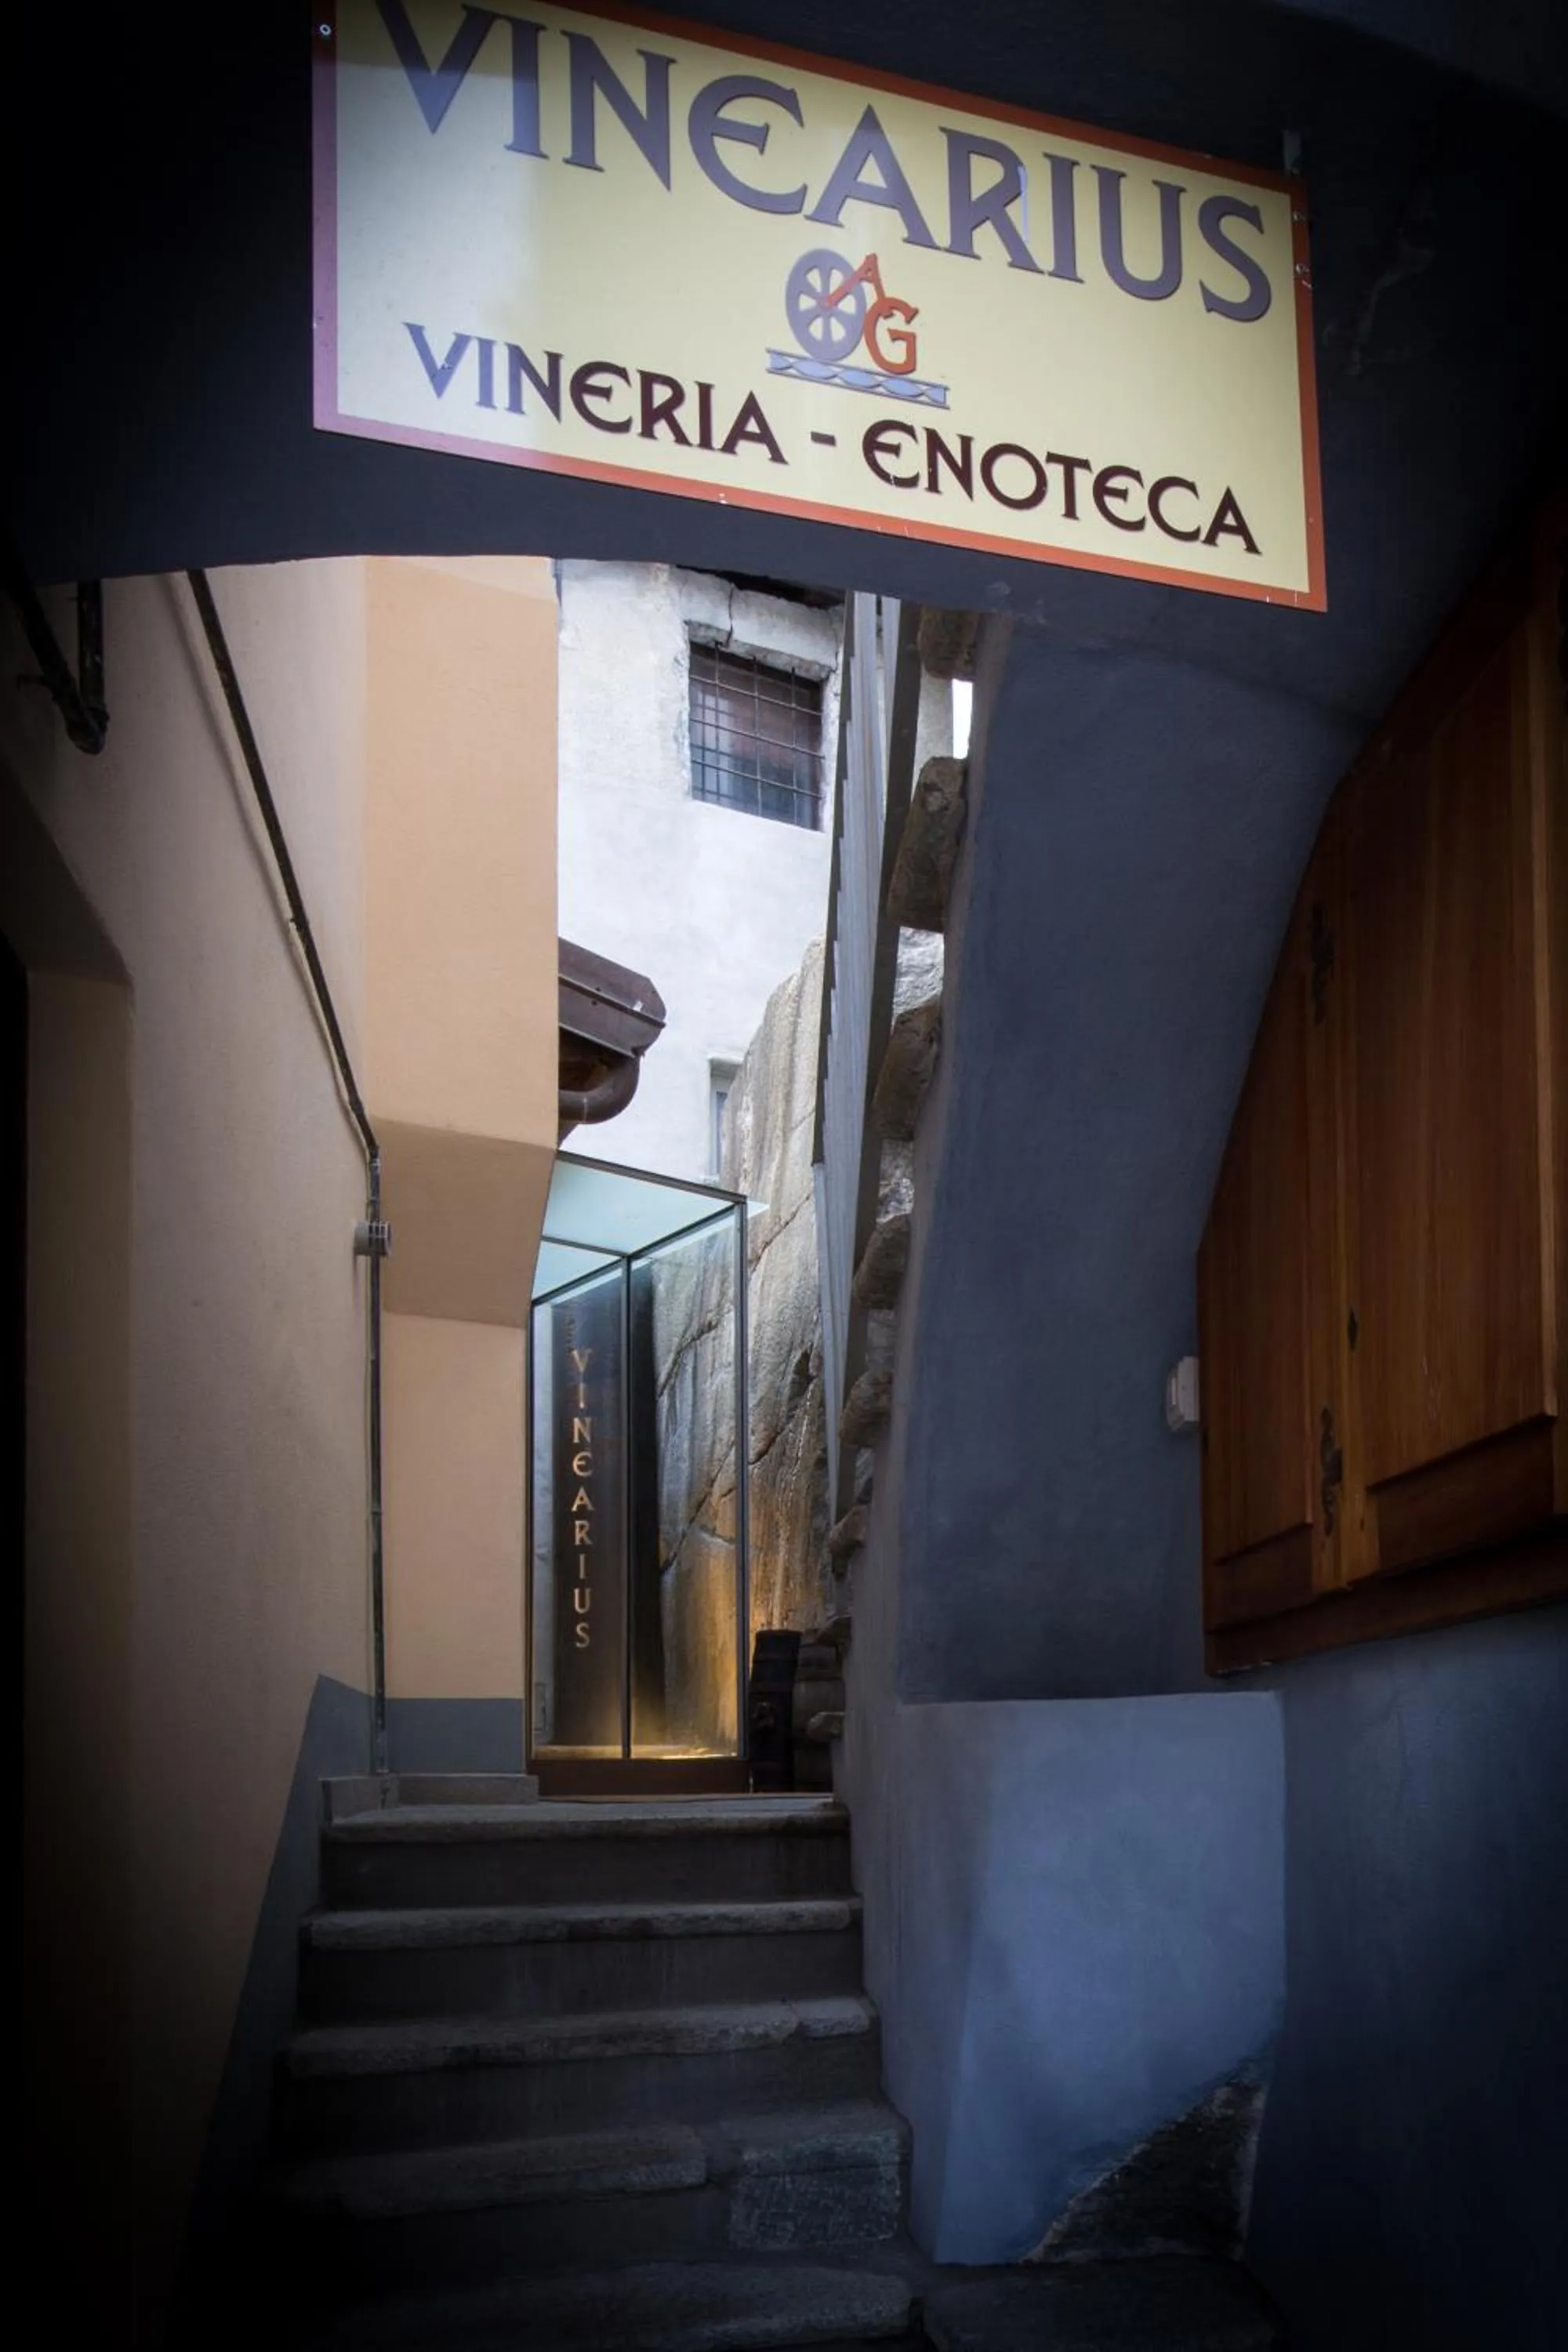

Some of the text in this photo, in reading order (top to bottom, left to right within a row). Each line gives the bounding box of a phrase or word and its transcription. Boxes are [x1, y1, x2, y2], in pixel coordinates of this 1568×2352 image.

[375, 0, 1272, 322] VINEARIUS
[403, 321, 788, 464] VINERIA
[863, 419, 1261, 555] ENOTECA
[571, 1348, 595, 1648] VINEARIUS
